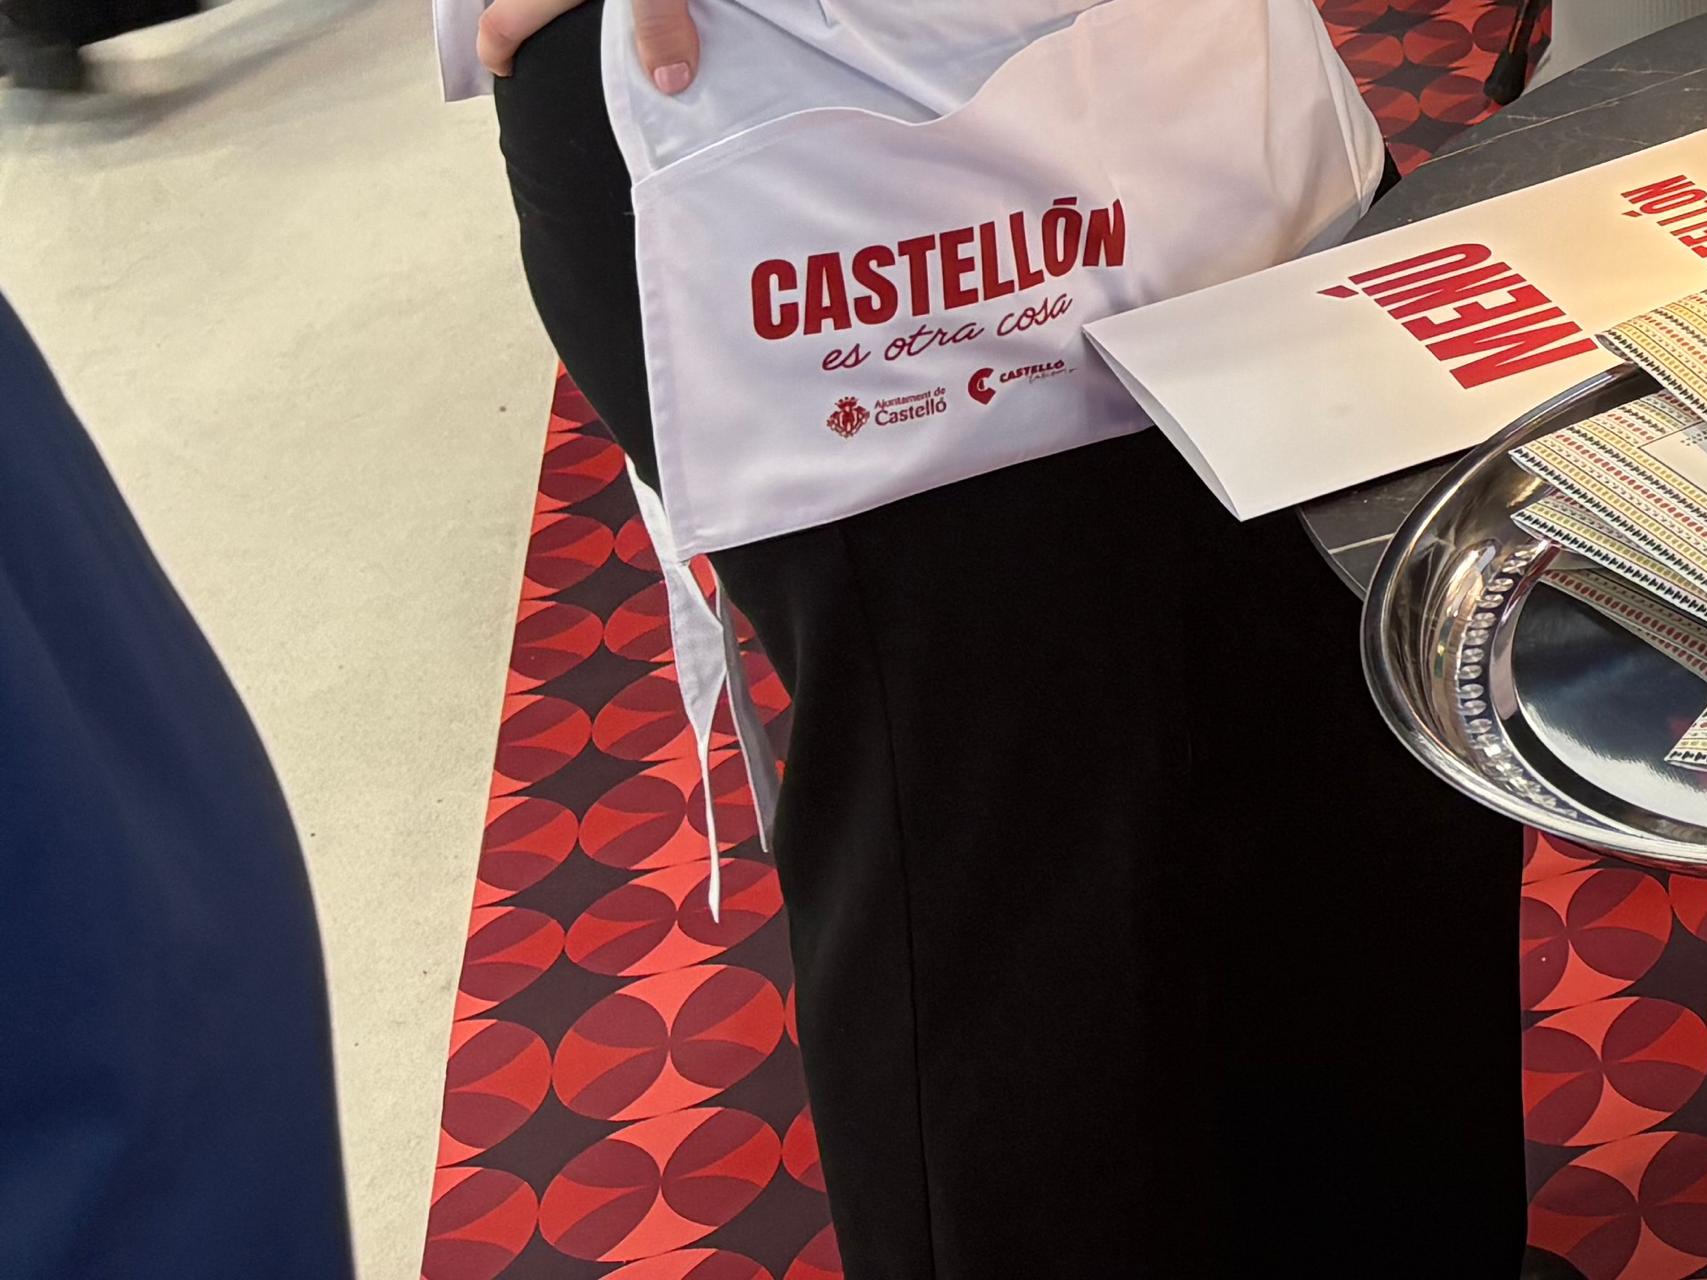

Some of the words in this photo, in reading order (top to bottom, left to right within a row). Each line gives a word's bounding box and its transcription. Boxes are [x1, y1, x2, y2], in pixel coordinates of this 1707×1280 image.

[751, 196, 1127, 341] CASTELLÓN
[821, 341, 872, 371] es
[883, 321, 986, 363] otra
[995, 293, 1074, 338] cosa
[1316, 243, 1599, 390] MENÚ
[874, 389, 932, 410] Ajuntament
[933, 386, 947, 398] de
[999, 359, 1065, 384] CASTELLÓ
[874, 395, 947, 426] Castelló
